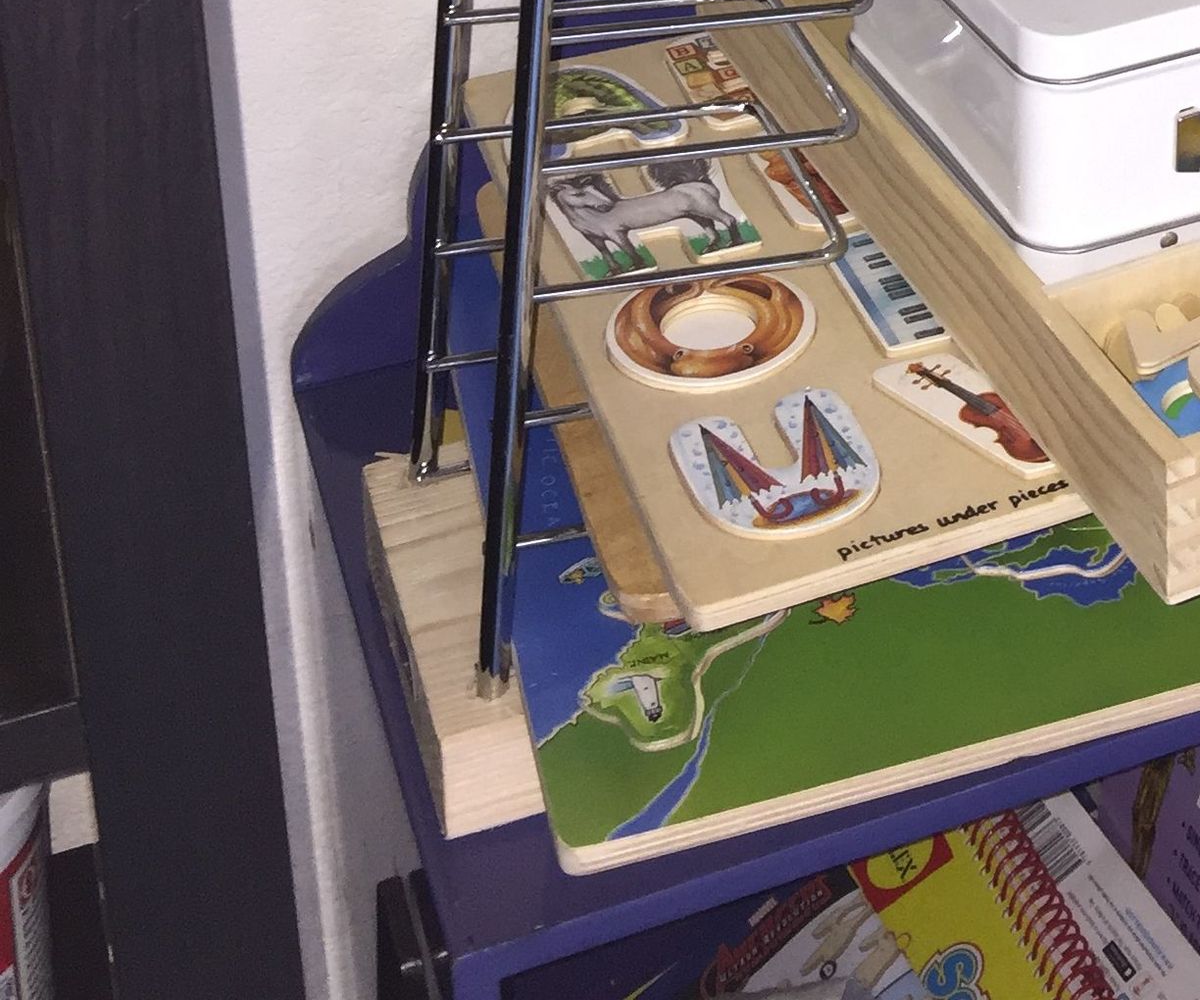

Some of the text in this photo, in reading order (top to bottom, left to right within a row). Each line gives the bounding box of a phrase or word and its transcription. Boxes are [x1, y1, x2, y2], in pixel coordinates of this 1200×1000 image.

[836, 478, 1070, 562] pictures under pieces
